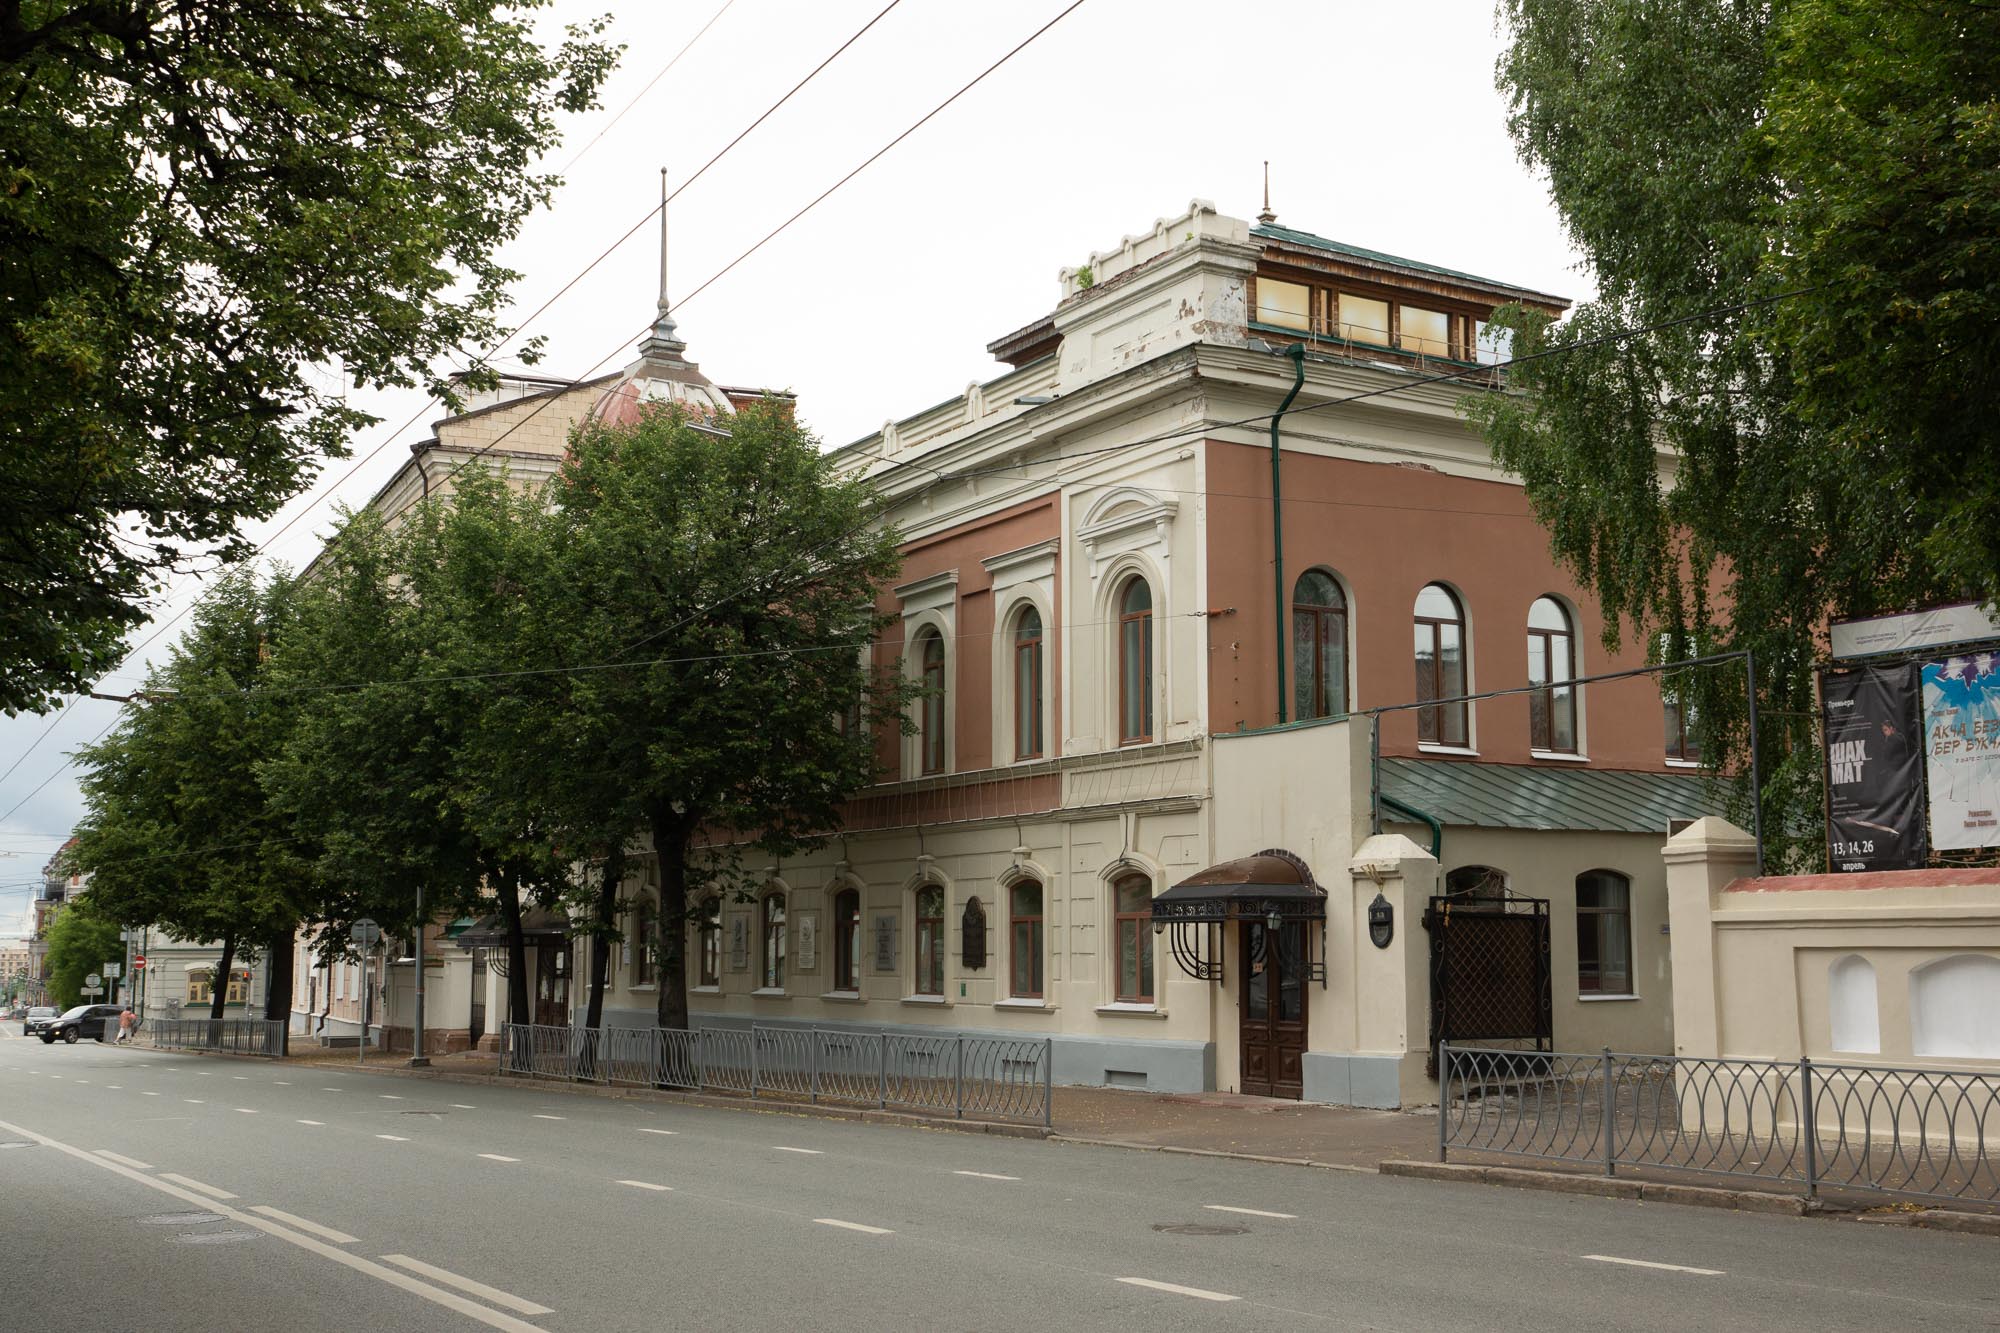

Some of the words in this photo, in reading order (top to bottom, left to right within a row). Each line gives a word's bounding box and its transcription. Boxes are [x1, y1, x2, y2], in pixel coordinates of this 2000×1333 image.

[1932, 722, 1967, 740] АКЧА
[1934, 740, 1960, 756] БЕР
[1831, 761, 1864, 785] МАТ
[1833, 842, 1846, 856] 13,
[1849, 841, 1862, 855] 14,
[1862, 840, 1874, 853] 26
[1842, 862, 1866, 872] апрель
